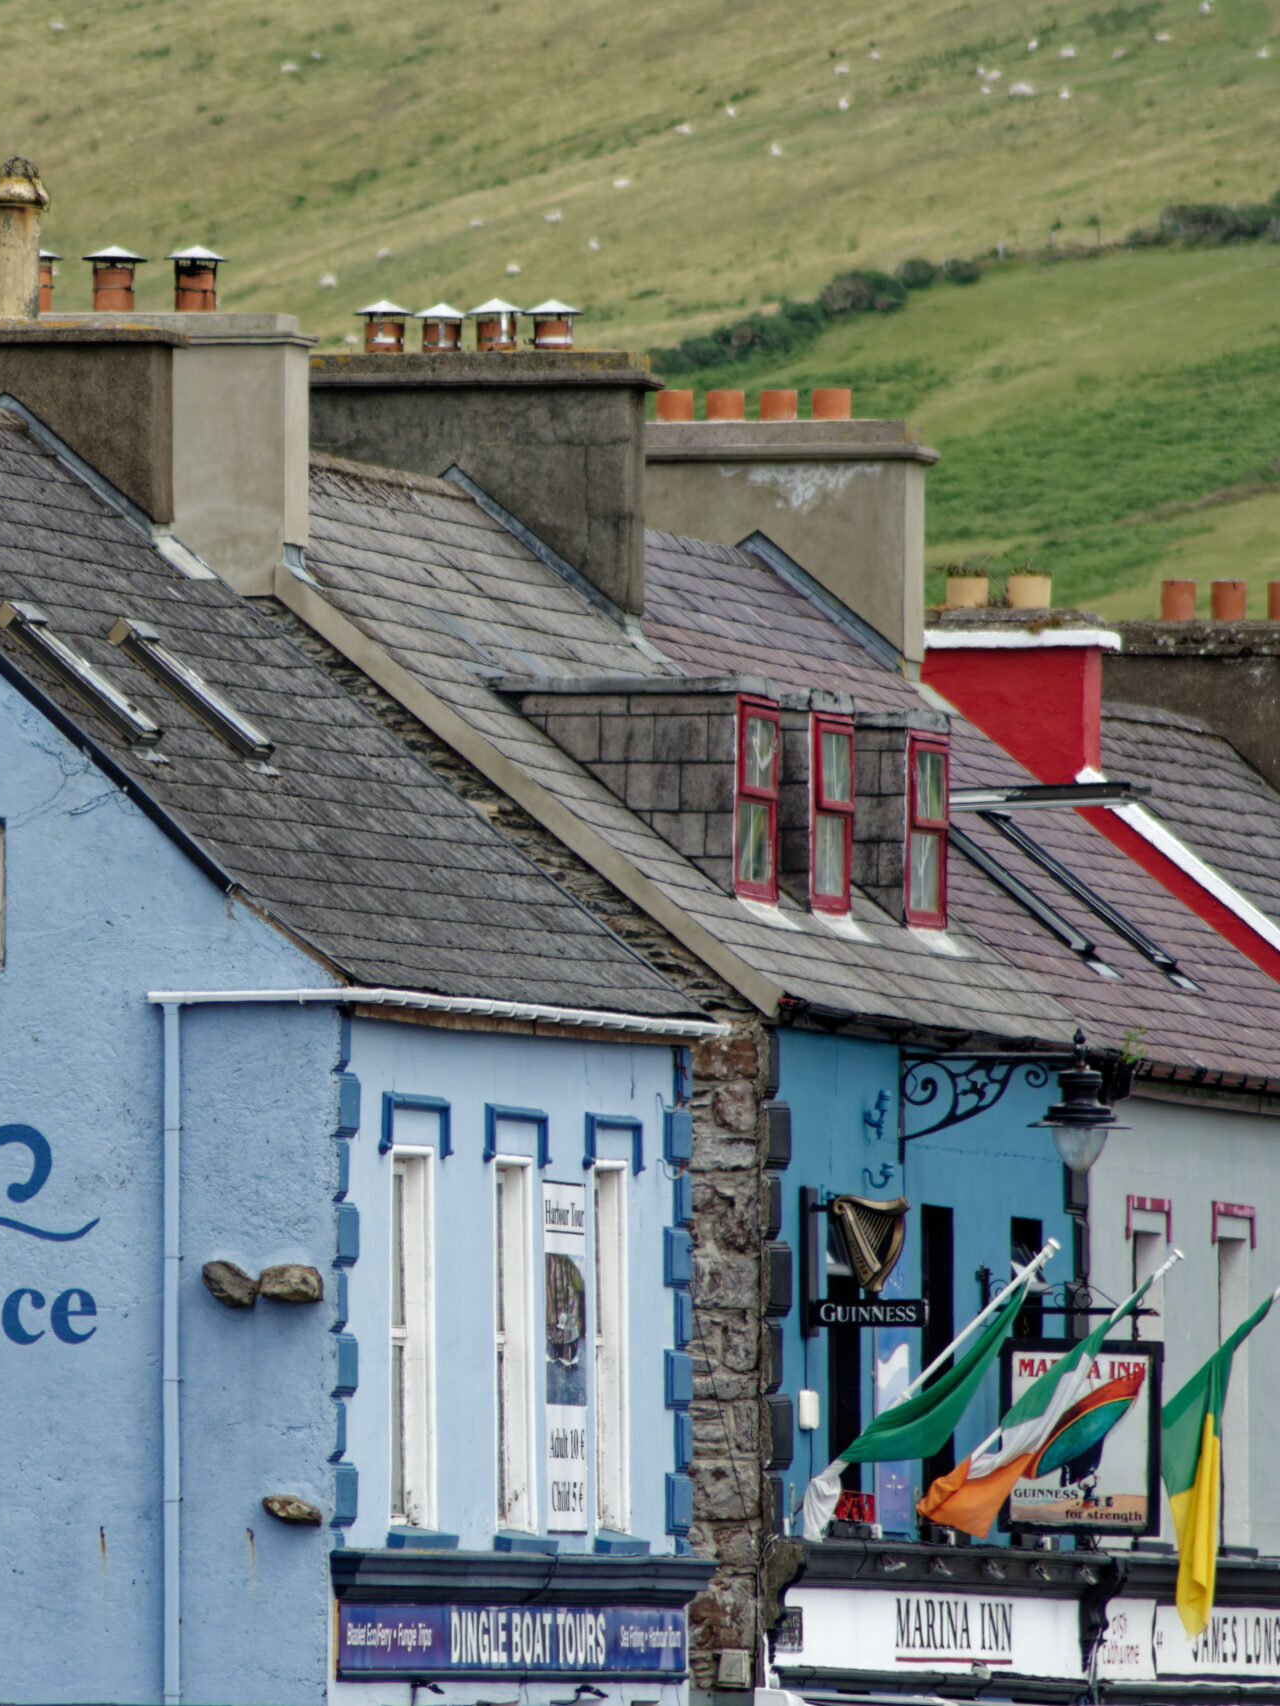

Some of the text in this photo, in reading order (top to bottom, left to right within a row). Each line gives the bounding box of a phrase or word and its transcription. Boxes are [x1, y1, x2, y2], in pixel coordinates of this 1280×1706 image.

[545, 1199, 584, 1228] Harbour Tour
[820, 1303, 917, 1322] GUINNESS
[1108, 1360, 1146, 1383] INN
[549, 1428, 568, 1459] Adult
[570, 1429, 578, 1459] 10
[551, 1481, 570, 1512] Child
[571, 1481, 577, 1512] 5
[1013, 1487, 1079, 1500] GUINNESS
[1065, 1508, 1142, 1522] for strength
[418, 1623, 432, 1652] Trips
[450, 1611, 606, 1665] DINGLE BOAT TOURS
[895, 1598, 1013, 1652] MARINA INN
[1192, 1616, 1237, 1663] JAMES
